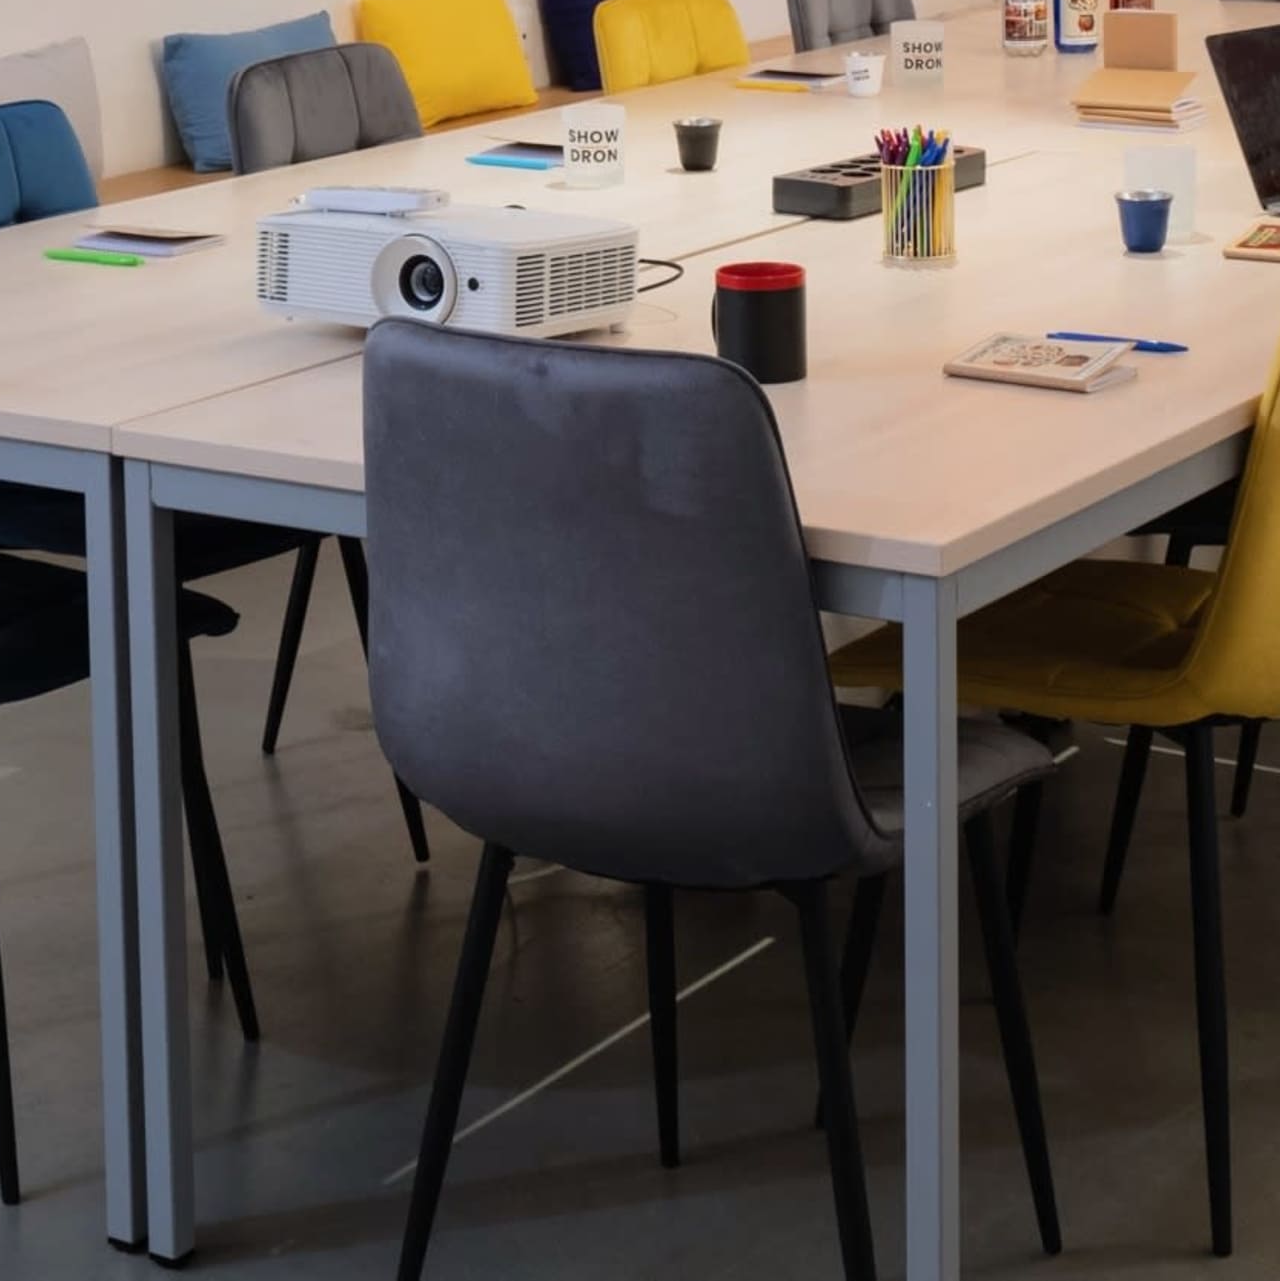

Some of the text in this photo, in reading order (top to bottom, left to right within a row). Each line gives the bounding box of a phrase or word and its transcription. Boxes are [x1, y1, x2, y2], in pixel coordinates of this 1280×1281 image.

[903, 41, 943, 54] SHOW
[904, 58, 943, 70] DRON
[569, 128, 619, 143] SHOW
[570, 149, 618, 163] DRON
